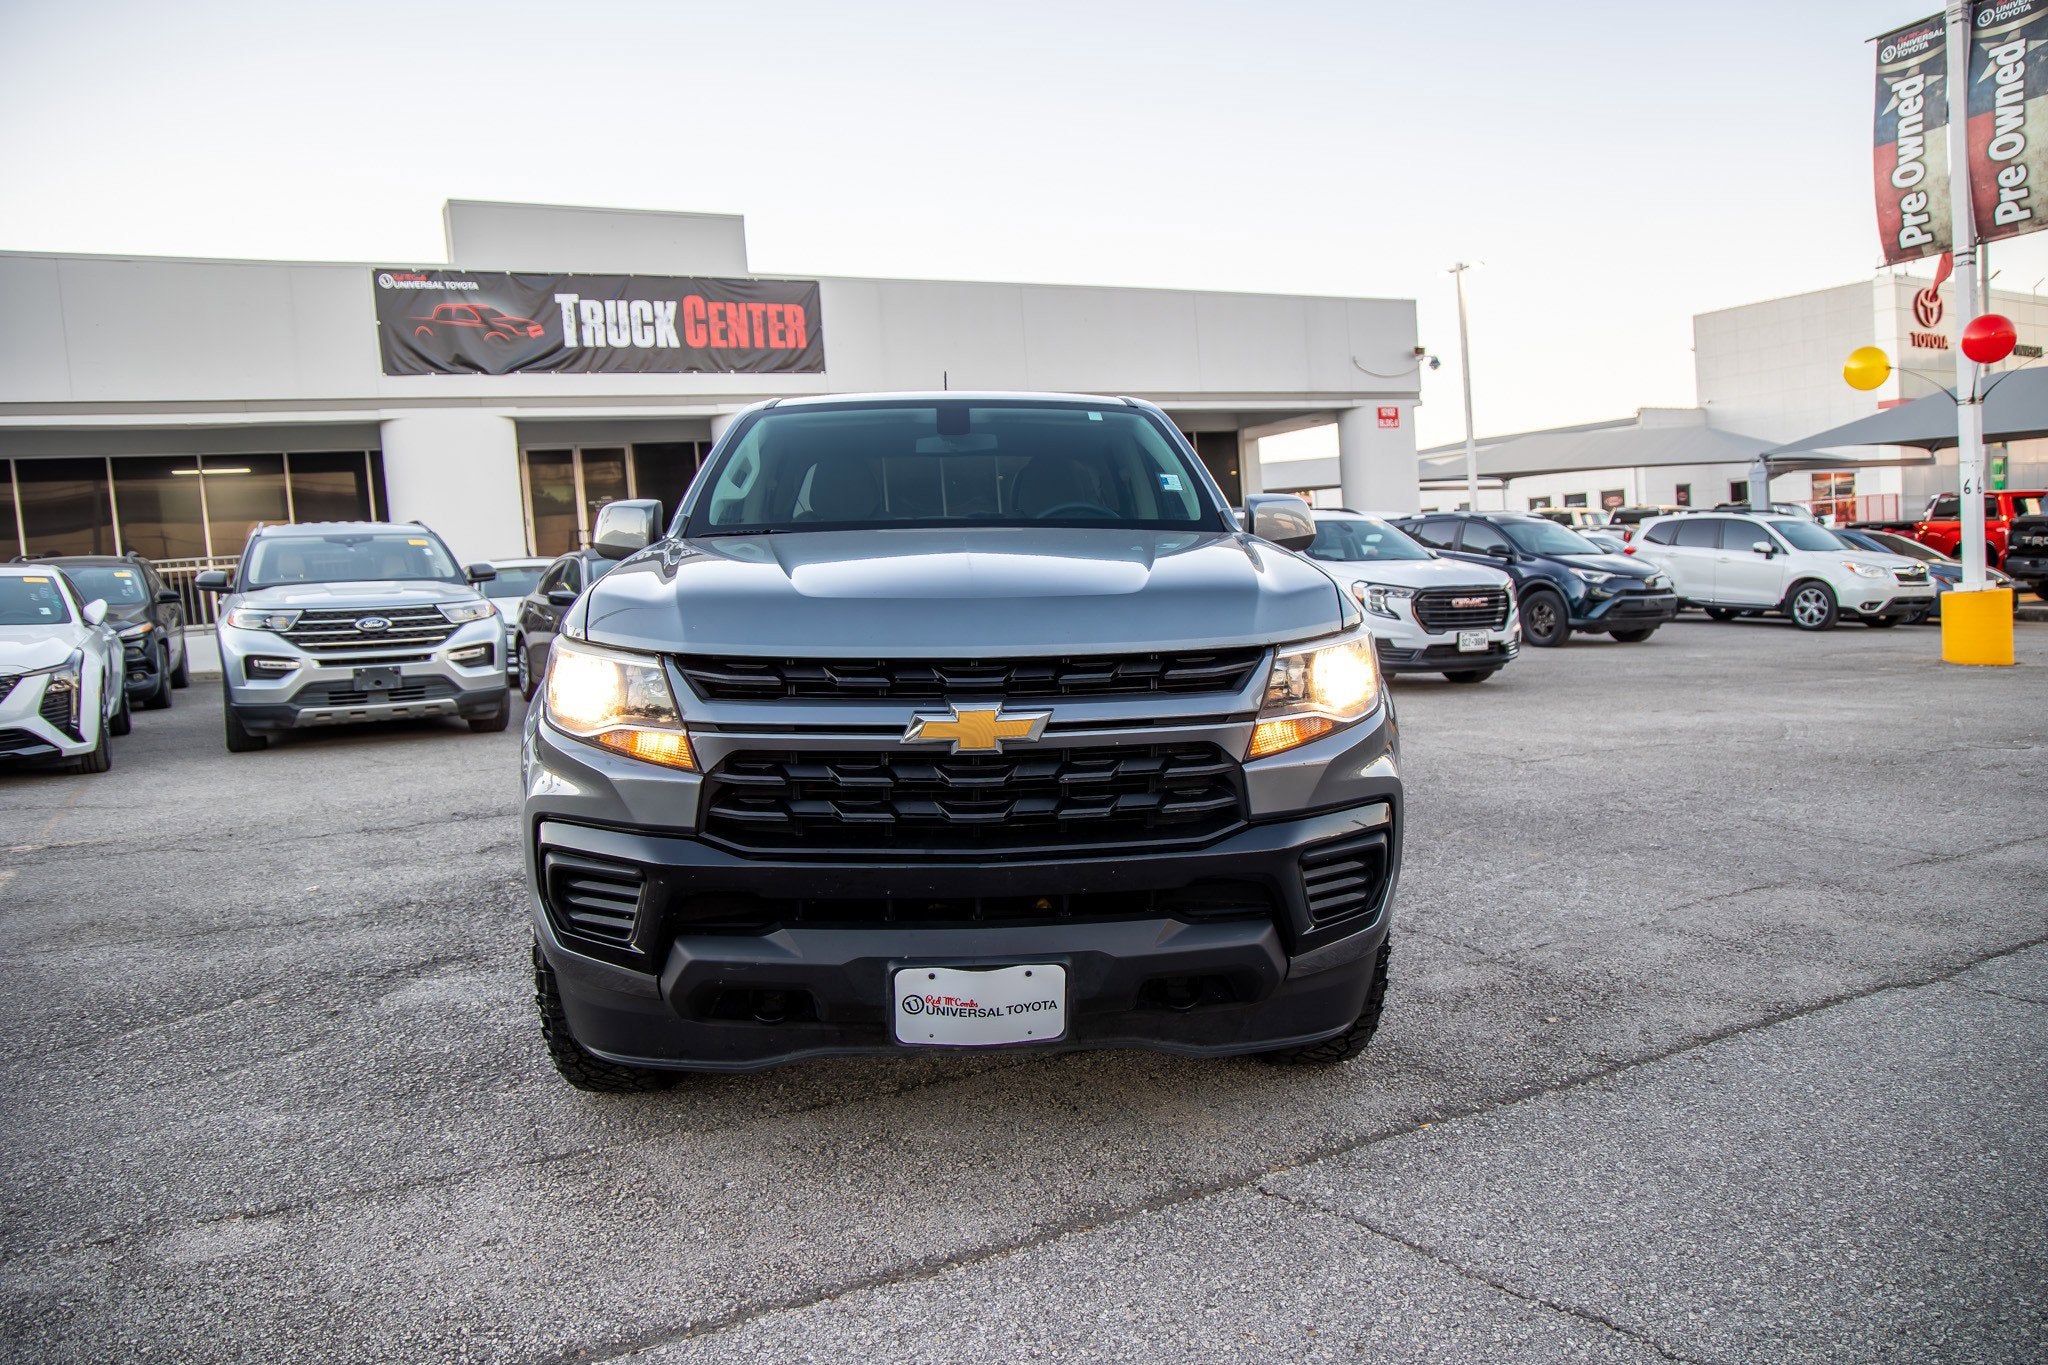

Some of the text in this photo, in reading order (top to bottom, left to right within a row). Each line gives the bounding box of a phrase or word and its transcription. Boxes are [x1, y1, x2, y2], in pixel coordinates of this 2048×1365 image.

[1995, 4, 2032, 22] TOYOTA
[1996, 0, 2034, 14] UNIVE
[1897, 28, 1945, 50] UNIVERSAL
[1896, 41, 1929, 58] TOYOTA
[1891, 74, 1925, 189] Owned
[1988, 37, 2032, 226] Pre Owned
[1899, 190, 1934, 249] Pre
[393, 280, 479, 290] UNIVERSAL TOYOTA
[1909, 332, 1949, 350] TOYOTA
[1963, 478, 1971, 495] 6
[1451, 597, 1488, 608] GMC
[926, 995, 941, 1008] Red
[926, 1000, 1058, 1018] UNIVERSAL TOYOTA
